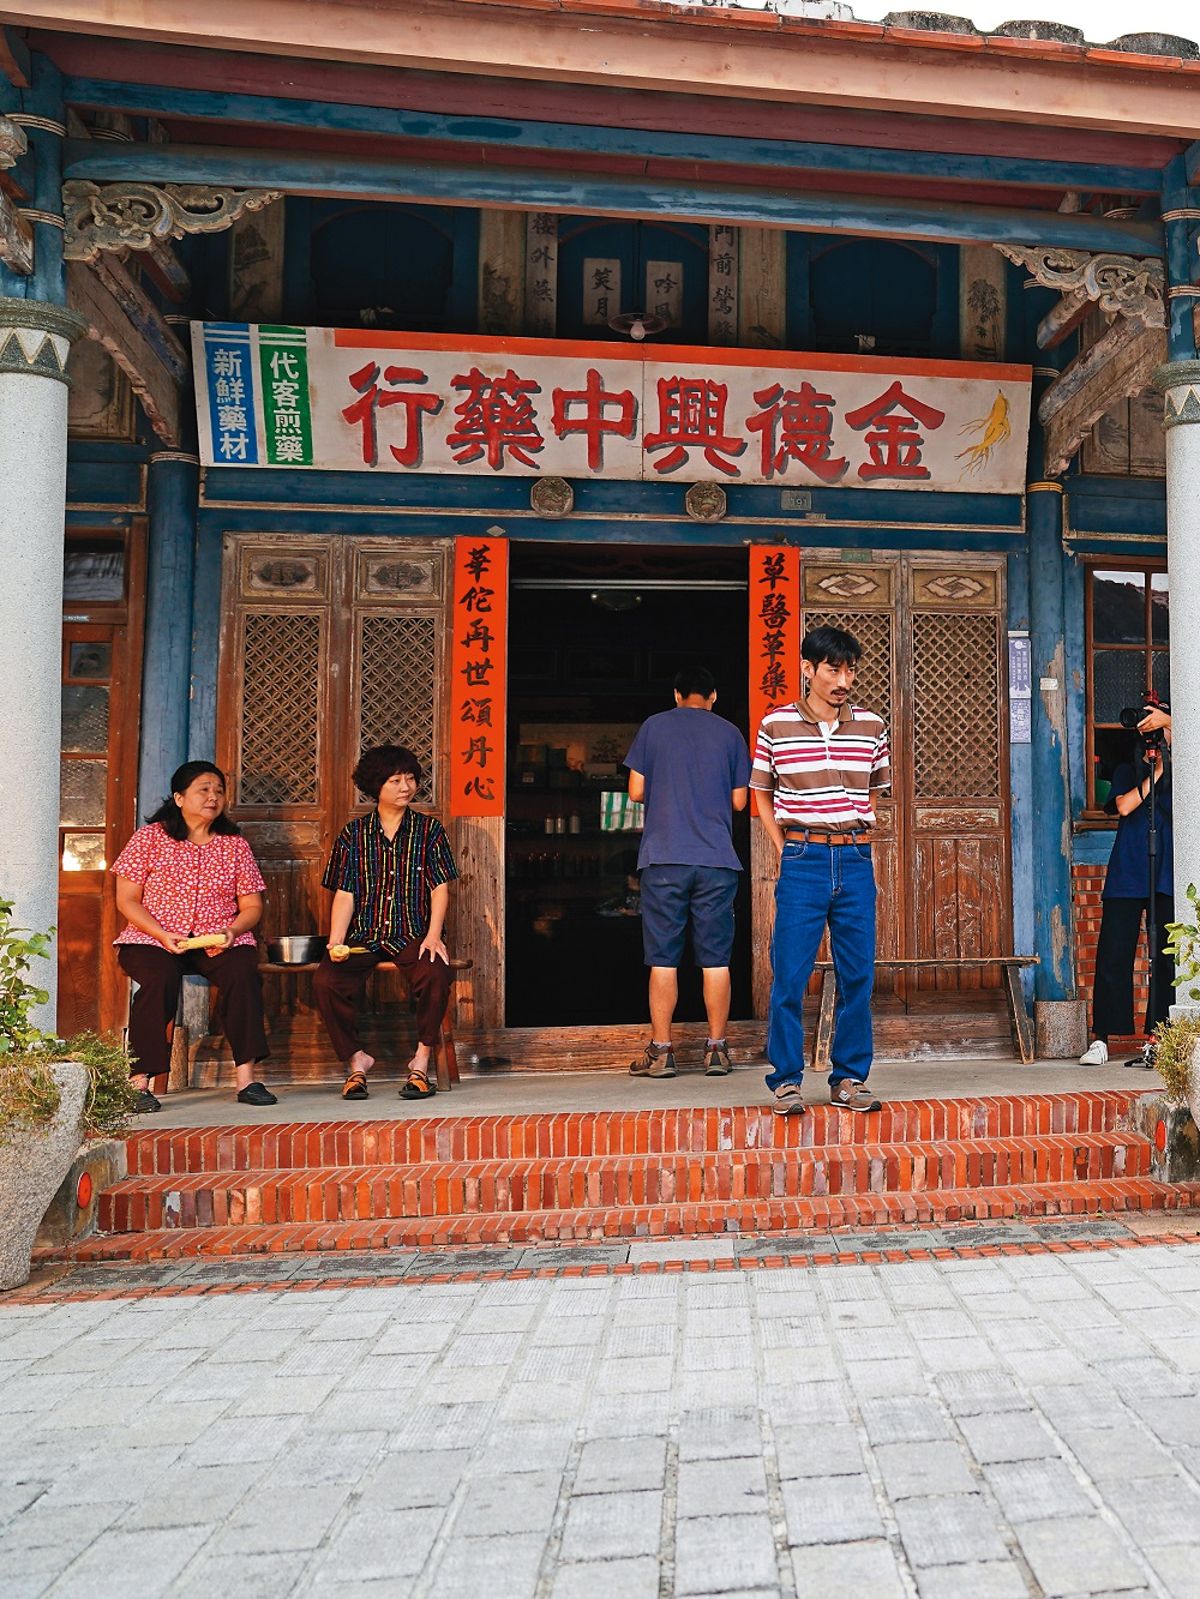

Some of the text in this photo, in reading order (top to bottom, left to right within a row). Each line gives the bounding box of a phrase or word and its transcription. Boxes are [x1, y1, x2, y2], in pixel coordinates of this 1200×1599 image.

[591, 266, 615, 319] 笑月
[213, 348, 249, 461] 新鮮藥材
[269, 351, 305, 463] 代客煎藥
[341, 360, 946, 483] 金德興中藥行
[459, 543, 496, 801] 華佗再世頌丹心
[758, 552, 792, 714] 草醫草藥
